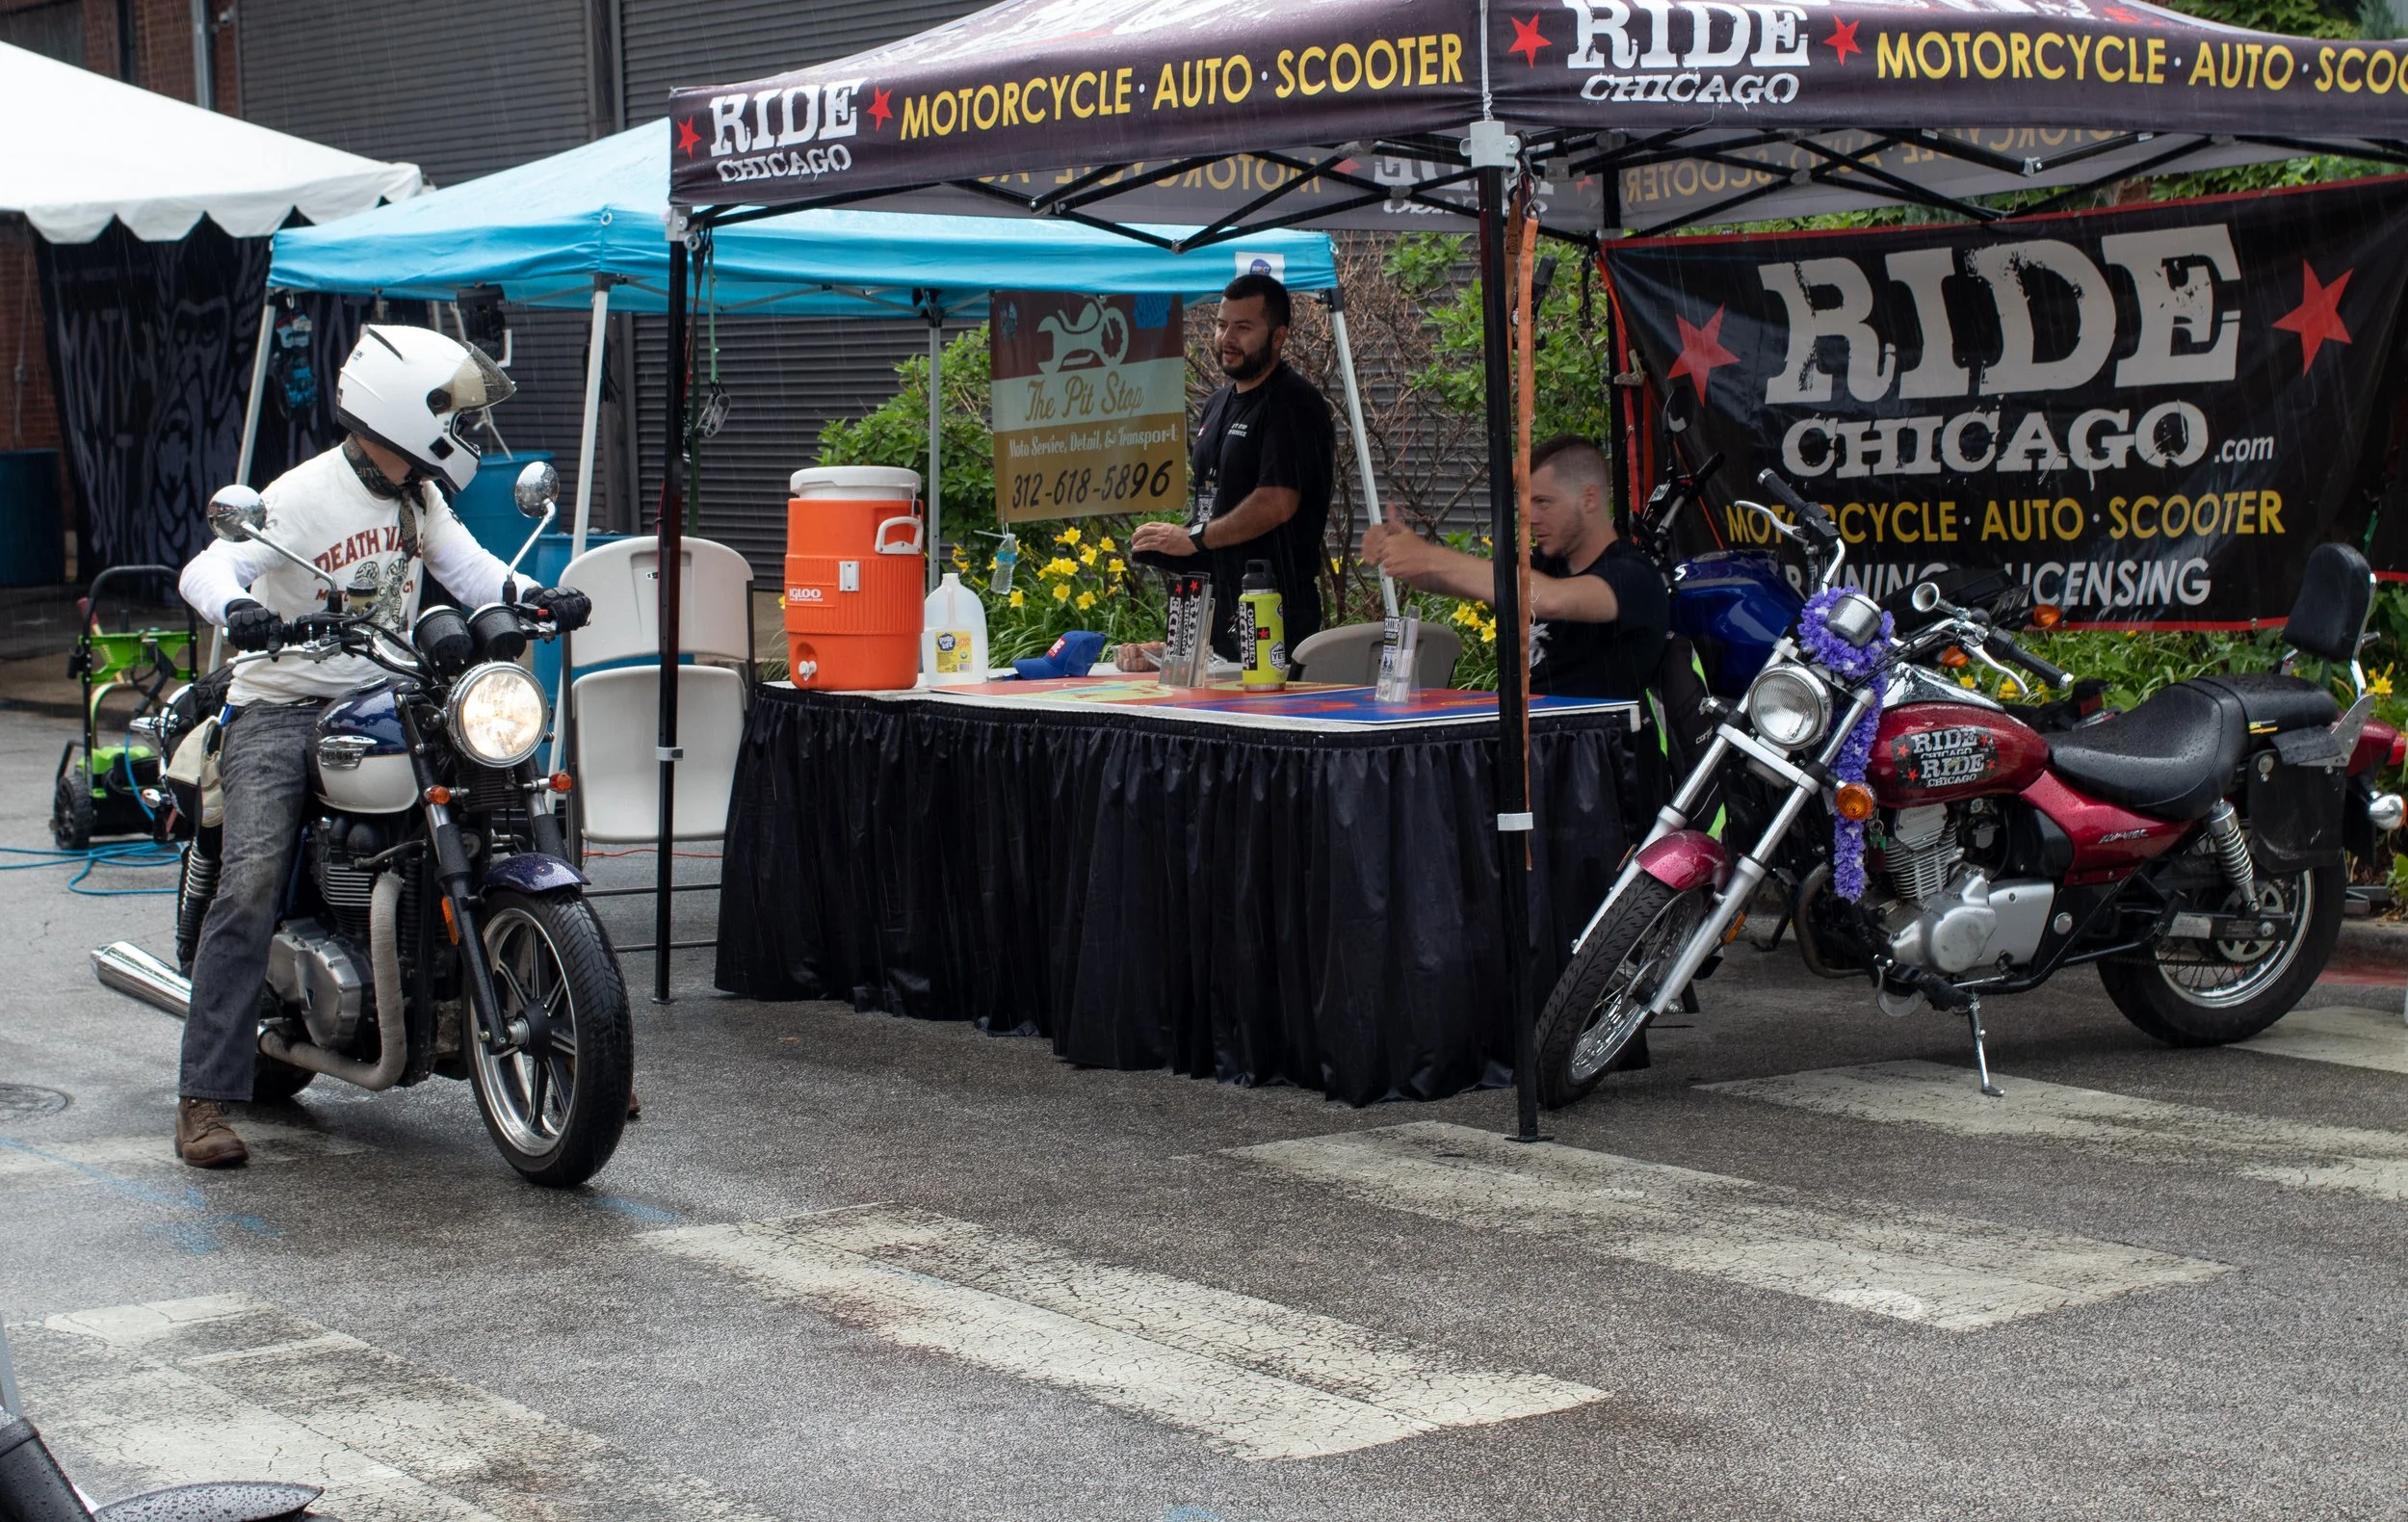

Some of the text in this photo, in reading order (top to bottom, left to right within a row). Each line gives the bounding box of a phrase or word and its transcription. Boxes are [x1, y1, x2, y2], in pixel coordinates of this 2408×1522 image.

[1562, 0, 1811, 69] RIDE
[900, 33, 1463, 141] MOTORCYCLE AUTO SCOOTER
[1876, 31, 2166, 85] MOTORCYCLE
[2187, 41, 2294, 92] AUTO
[1580, 71, 1800, 108] CHICAGO
[708, 77, 870, 158] RIDE
[716, 144, 852, 182] CHICAGO
[1757, 223, 2242, 406] RIDE
[1025, 370, 1145, 422] The Pit Stop
[1032, 434, 1067, 458] Service,
[1070, 429, 1103, 453] Detail,
[1105, 430, 1115, 449] &
[1117, 423, 1179, 451] Transport
[1782, 400, 2209, 482] CHICAGO
[1012, 459, 1174, 510] 312-618-5896
[1725, 489, 2287, 544] MOTCYCLE AUTO SCOOTER
[313, 528, 381, 580] DEATH
[2004, 556, 2212, 607] ICENSING
[1164, 596, 1182, 664] RIDE
[1247, 608, 1256, 664] CHICAGO
[1910, 727, 1978, 754] RIDE
[1921, 753, 1985, 779] RIDE
[1925, 774, 1977, 788] CHICAGO
